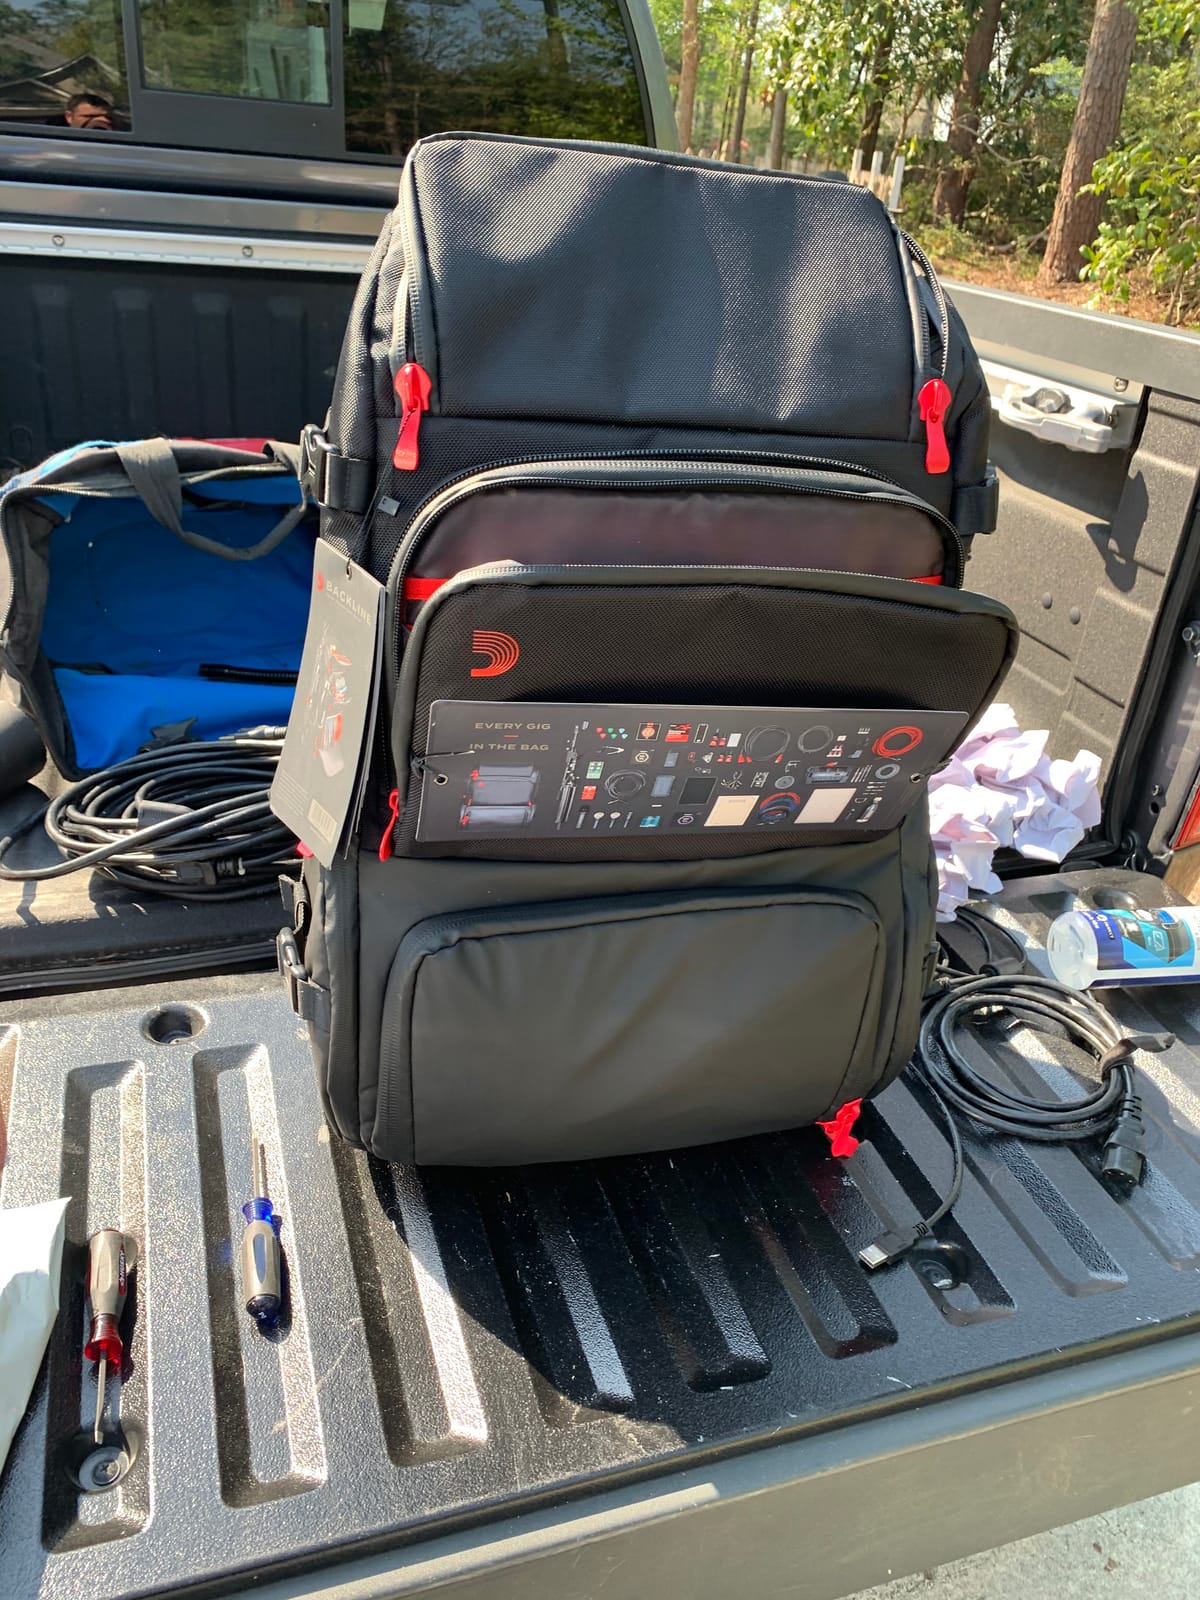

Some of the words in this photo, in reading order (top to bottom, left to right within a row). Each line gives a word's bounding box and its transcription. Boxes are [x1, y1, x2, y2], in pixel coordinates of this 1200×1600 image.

[326, 580, 373, 626] BACKLINE
[474, 722, 522, 730] EVERY
[526, 722, 551, 730] GIG
